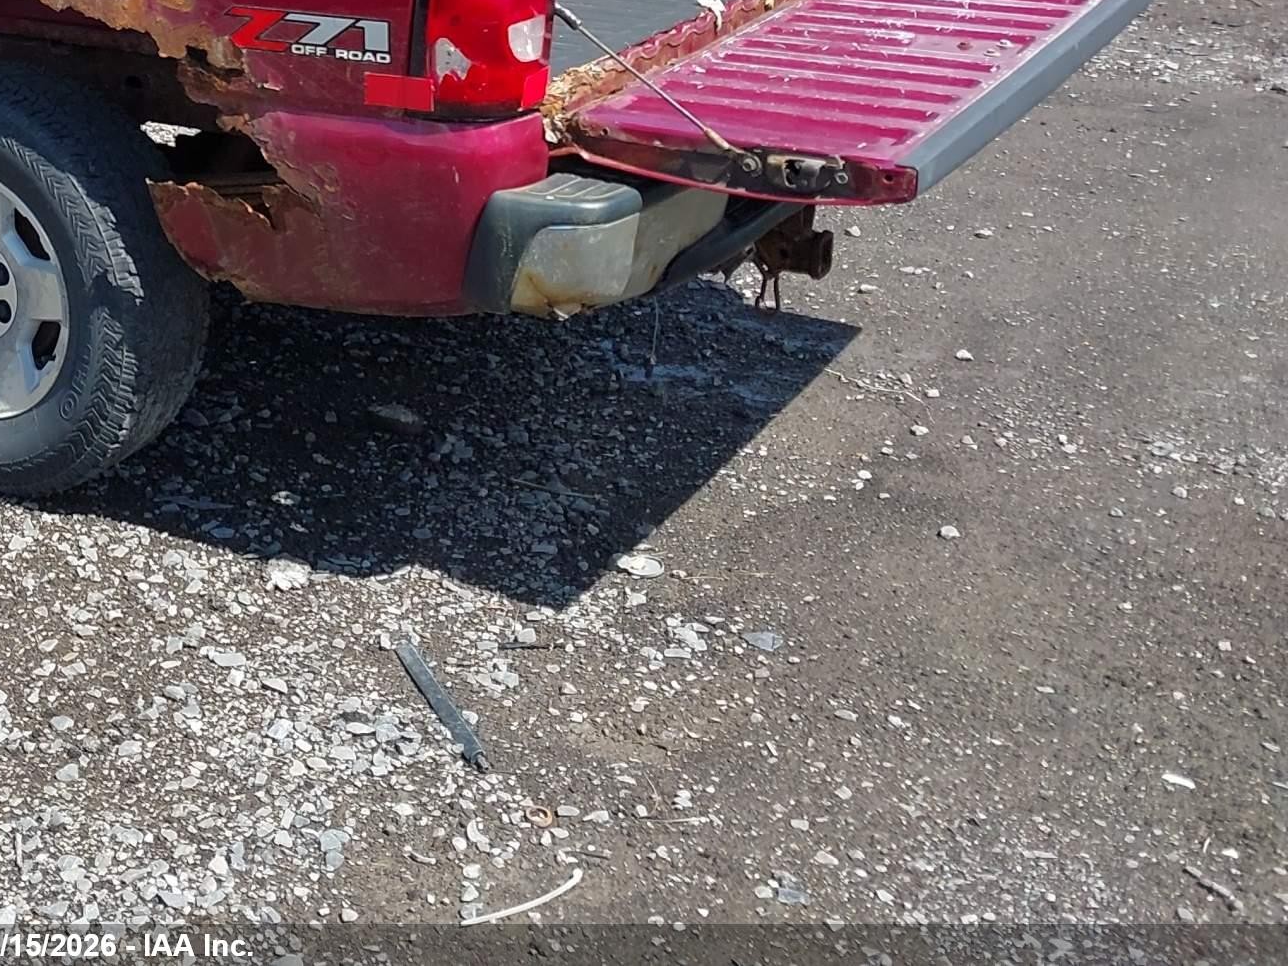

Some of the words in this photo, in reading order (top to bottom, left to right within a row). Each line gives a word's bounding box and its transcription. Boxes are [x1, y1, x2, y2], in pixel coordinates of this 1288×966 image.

[224, 5, 391, 53] Z71
[291, 44, 328, 57] OFF
[335, 48, 392, 65] ROAD
